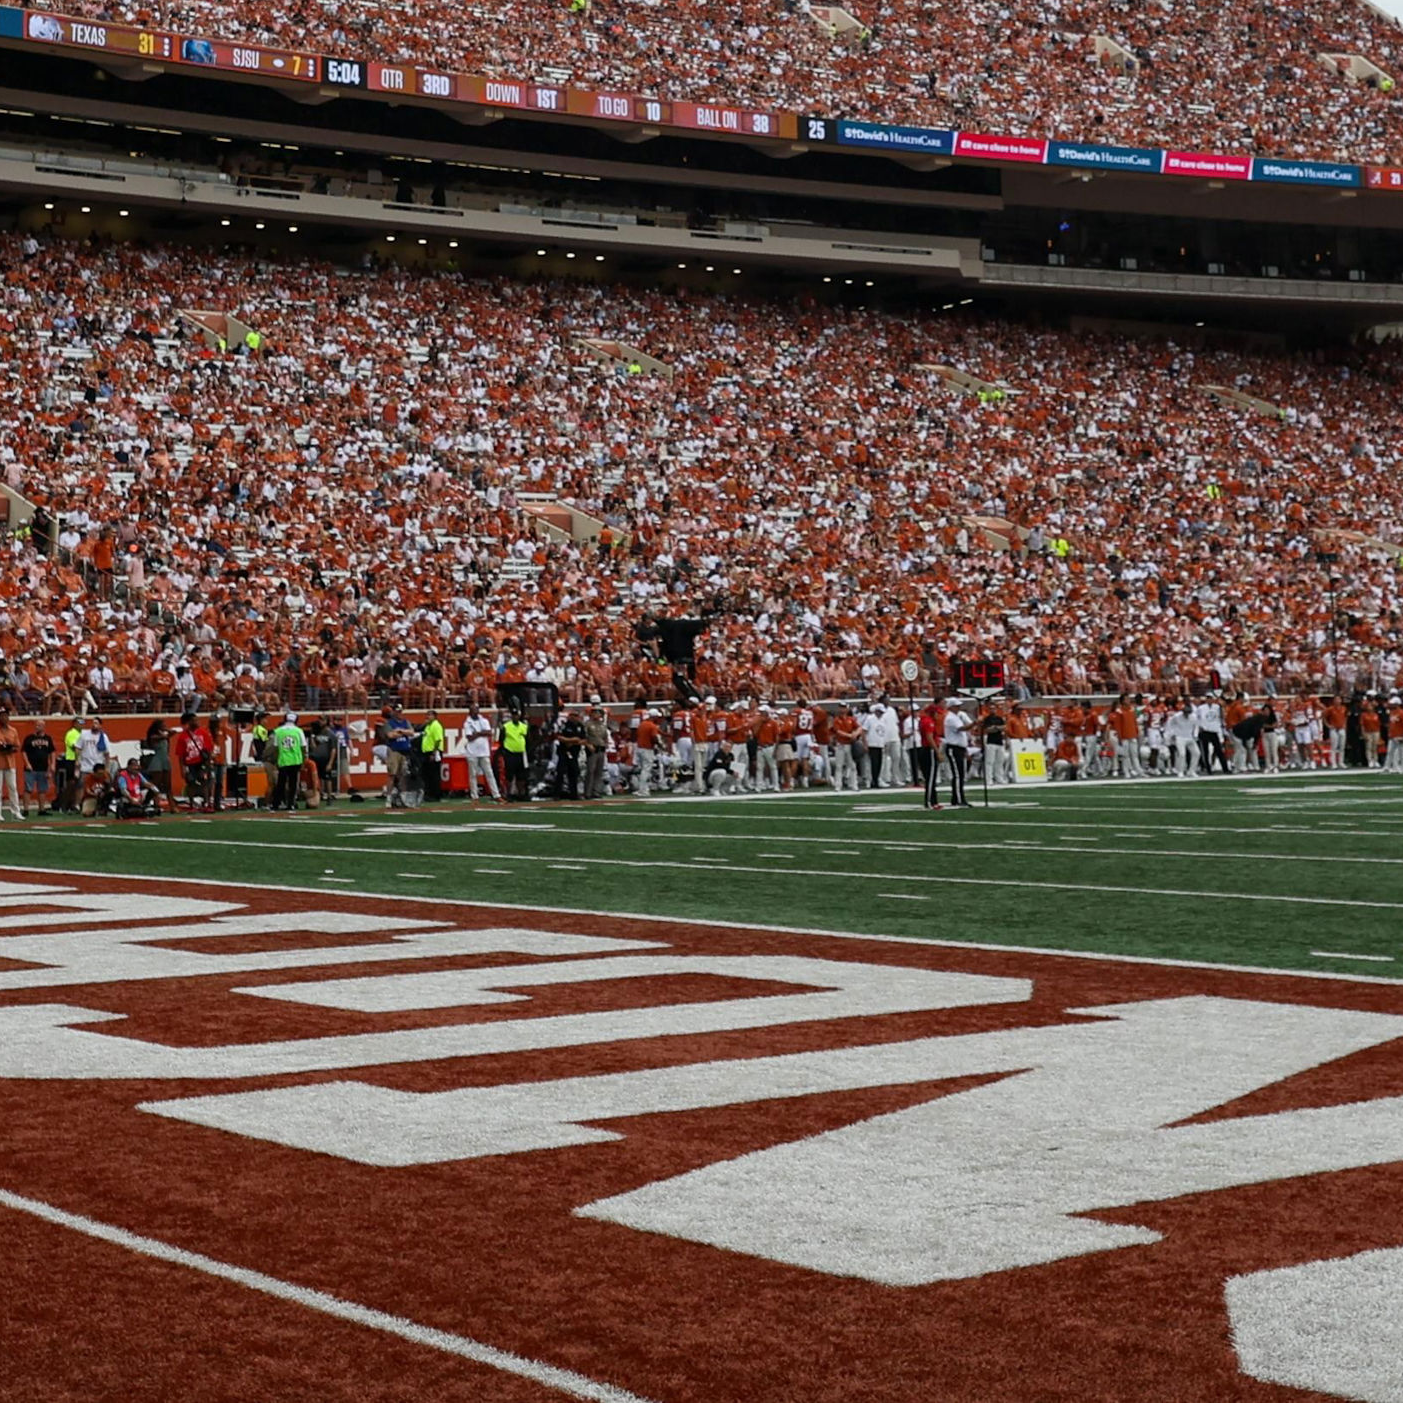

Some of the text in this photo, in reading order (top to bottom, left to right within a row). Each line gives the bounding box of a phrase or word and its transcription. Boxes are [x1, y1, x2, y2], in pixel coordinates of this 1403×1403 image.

[70, 23, 155, 55] TEXAS 31
[233, 48, 302, 76] SJSU 7
[328, 61, 361, 85] 5:04
[381, 68, 450, 97] QTR 3RD
[485, 82, 559, 110] DOWN 1ST
[598, 96, 661, 122] TO GO 10
[697, 107, 769, 133] BALL ON 38
[808, 120, 825, 140] 25
